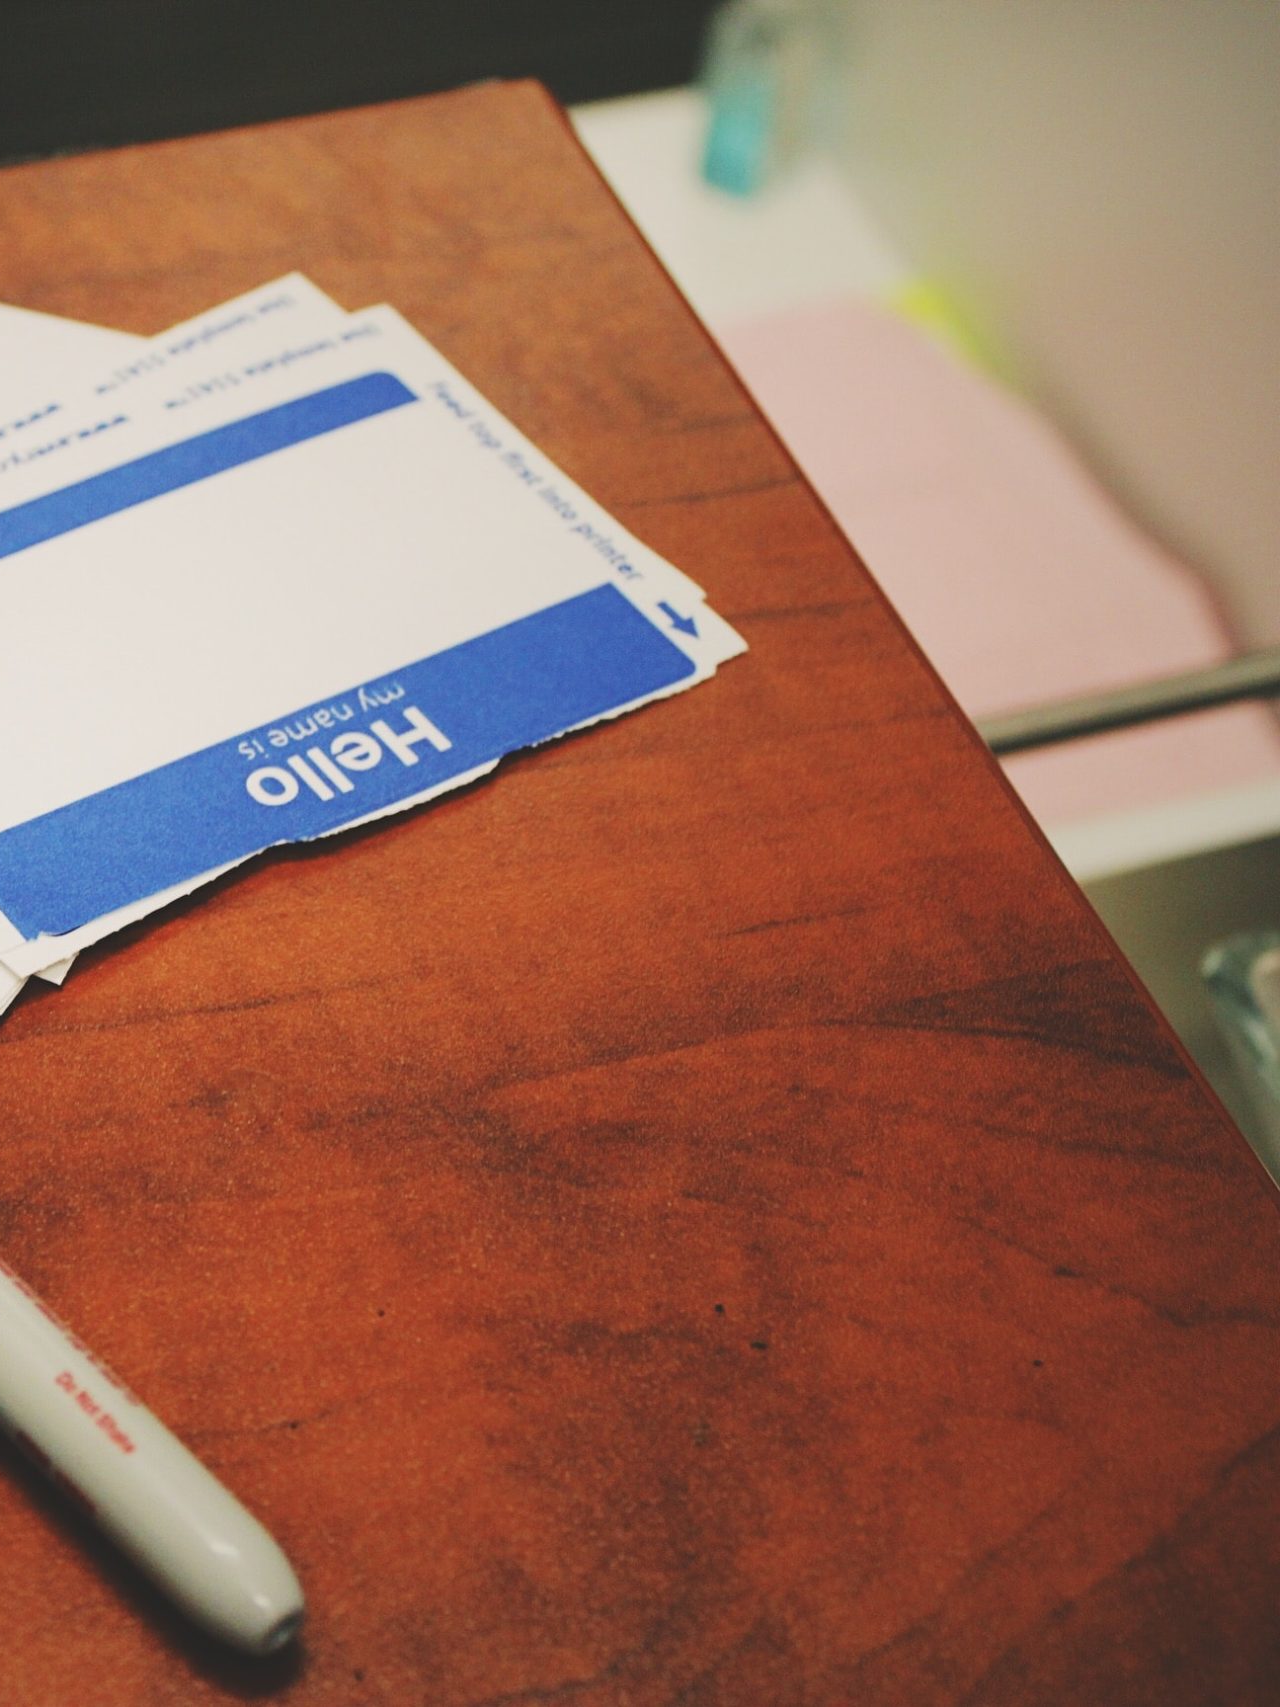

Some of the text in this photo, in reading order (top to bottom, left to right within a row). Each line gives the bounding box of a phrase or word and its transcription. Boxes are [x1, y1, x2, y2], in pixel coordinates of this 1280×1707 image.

[499, 450, 544, 488] first
[537, 483, 579, 522] into
[567, 524, 645, 583] printer
[236, 680, 406, 763] my name is
[245, 705, 452, 809] Hello
[53, 1369, 79, 1395] Do
[73, 1389, 102, 1417] Not
